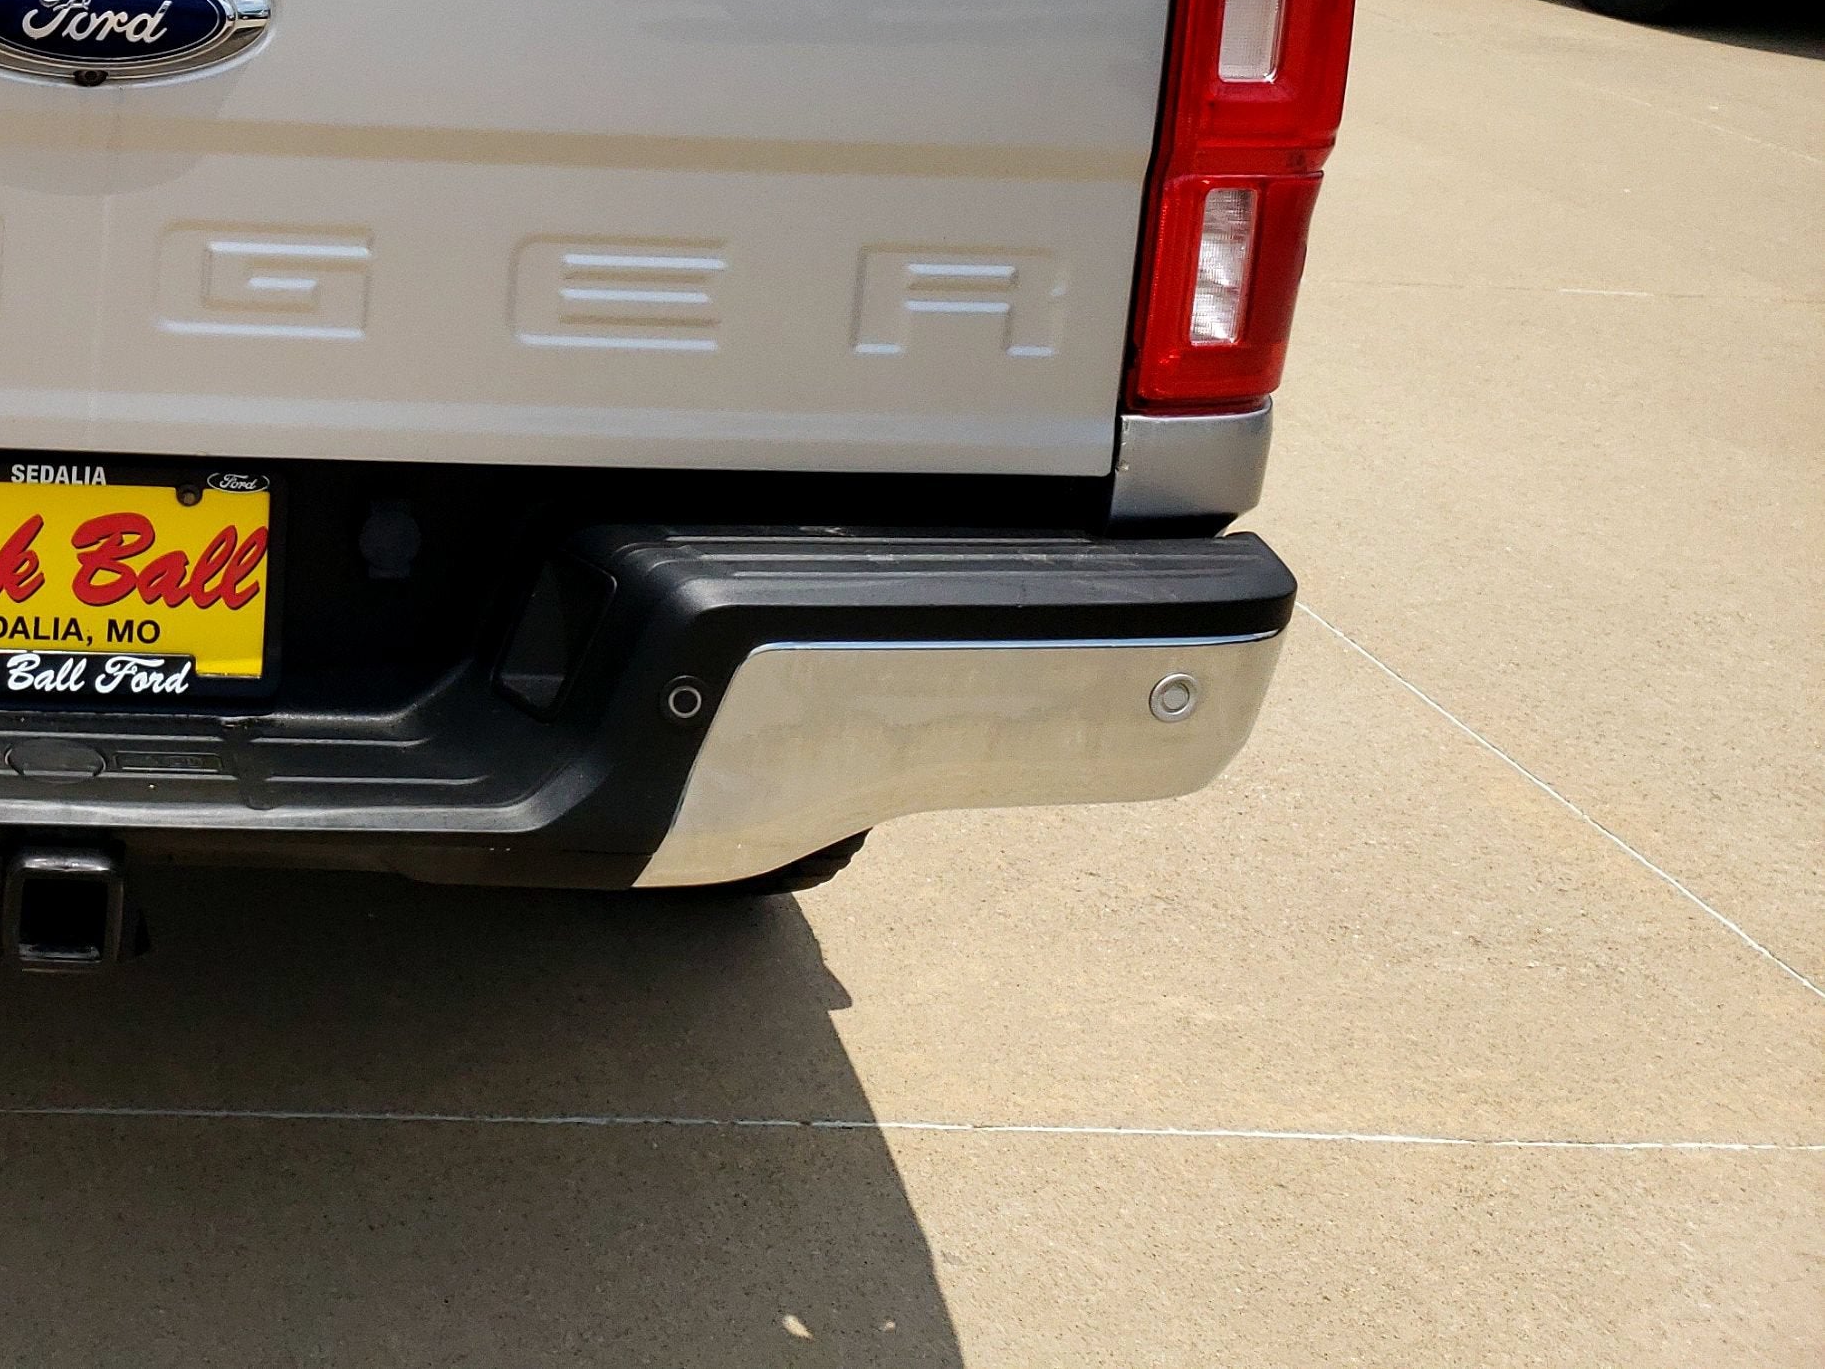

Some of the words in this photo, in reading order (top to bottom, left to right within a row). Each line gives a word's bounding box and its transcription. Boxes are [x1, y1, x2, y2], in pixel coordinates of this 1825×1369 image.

[10, 463, 107, 486] SEDALIA
[219, 473, 259, 490] Ford
[71, 512, 268, 610] Ball
[106, 619, 161, 643] MO
[6, 654, 85, 693] Ball
[95, 655, 192, 695] Ford
